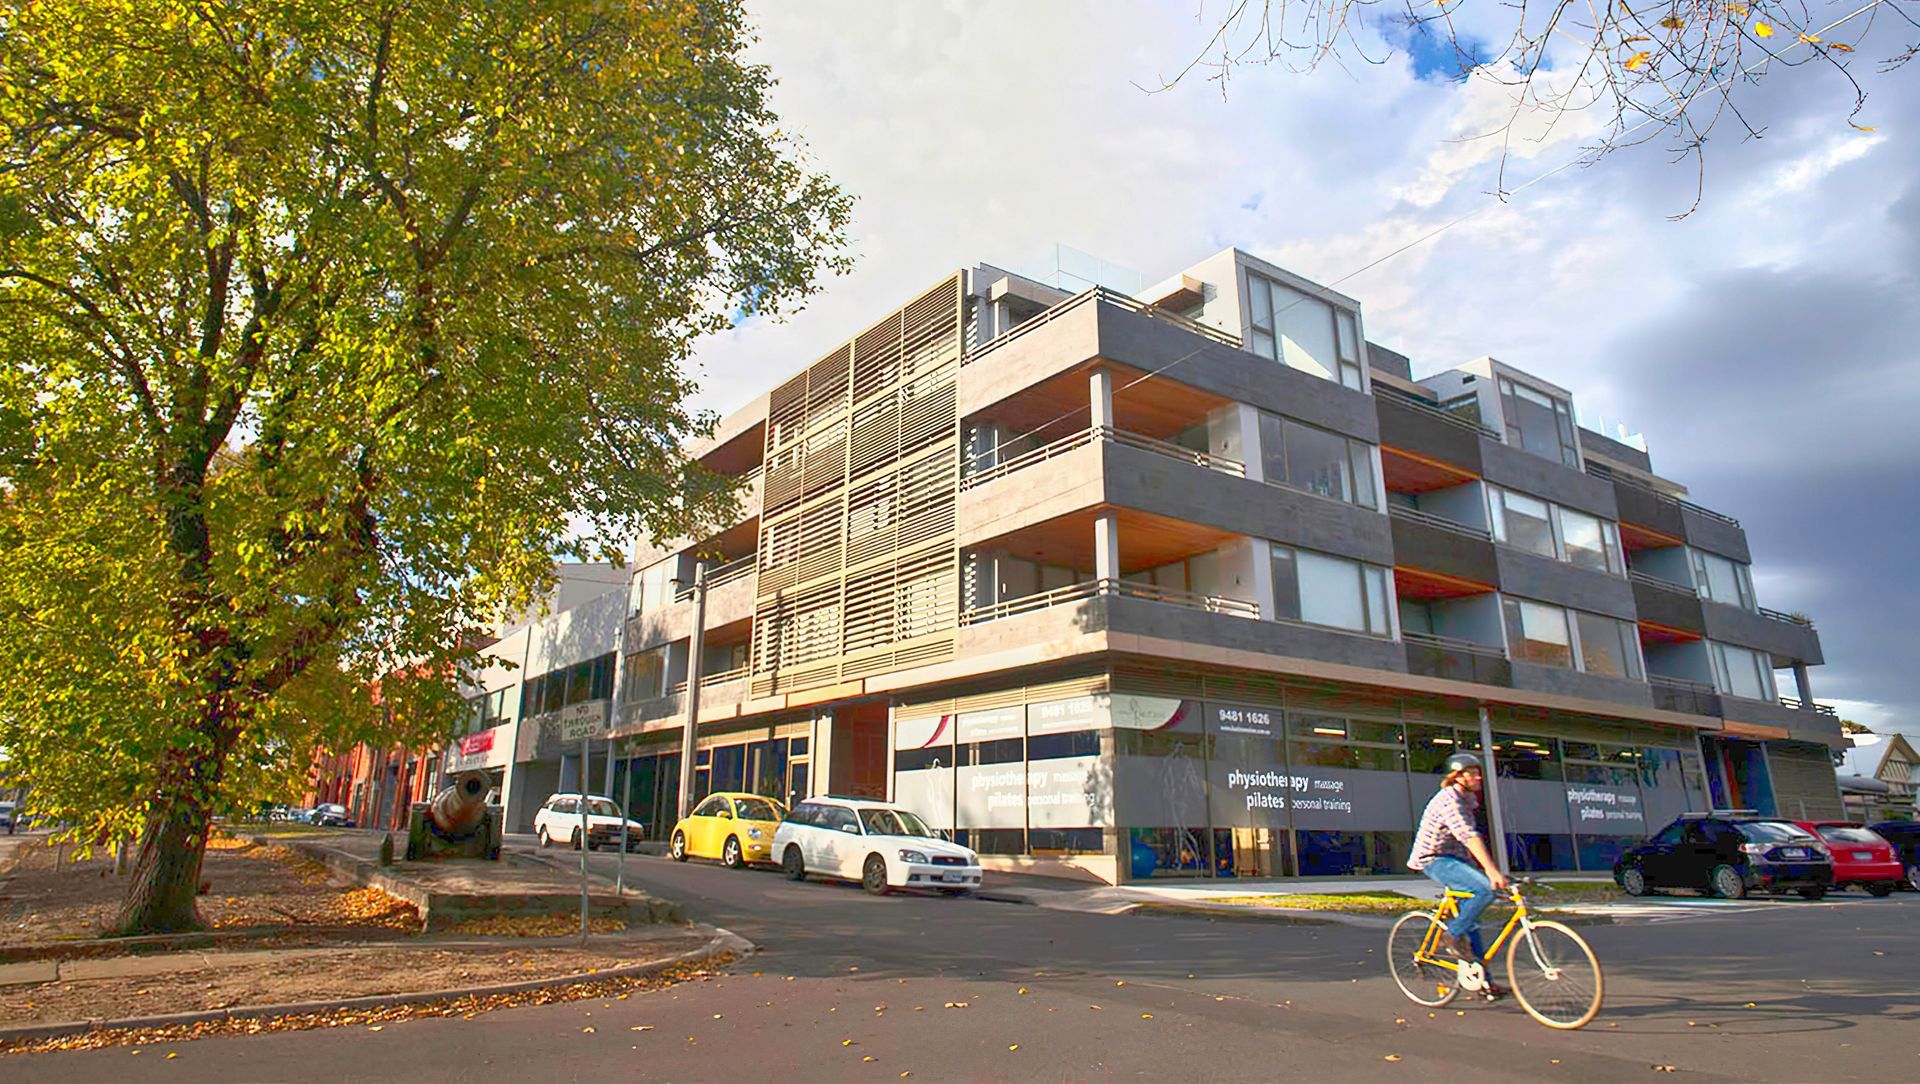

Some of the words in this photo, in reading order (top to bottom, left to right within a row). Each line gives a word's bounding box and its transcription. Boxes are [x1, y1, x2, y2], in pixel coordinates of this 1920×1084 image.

[576, 705, 589, 714] NO
[1219, 709, 1243, 722] 9481
[1246, 711, 1270, 725] 1626
[570, 725, 596, 738] ROAD
[971, 770, 1048, 792] physiotheapy
[1228, 769, 1309, 792] physiotherapy
[1314, 780, 1344, 792] massage
[987, 791, 1024, 811] pilates
[1246, 792, 1285, 811] pilates
[1323, 799, 1352, 813] training
